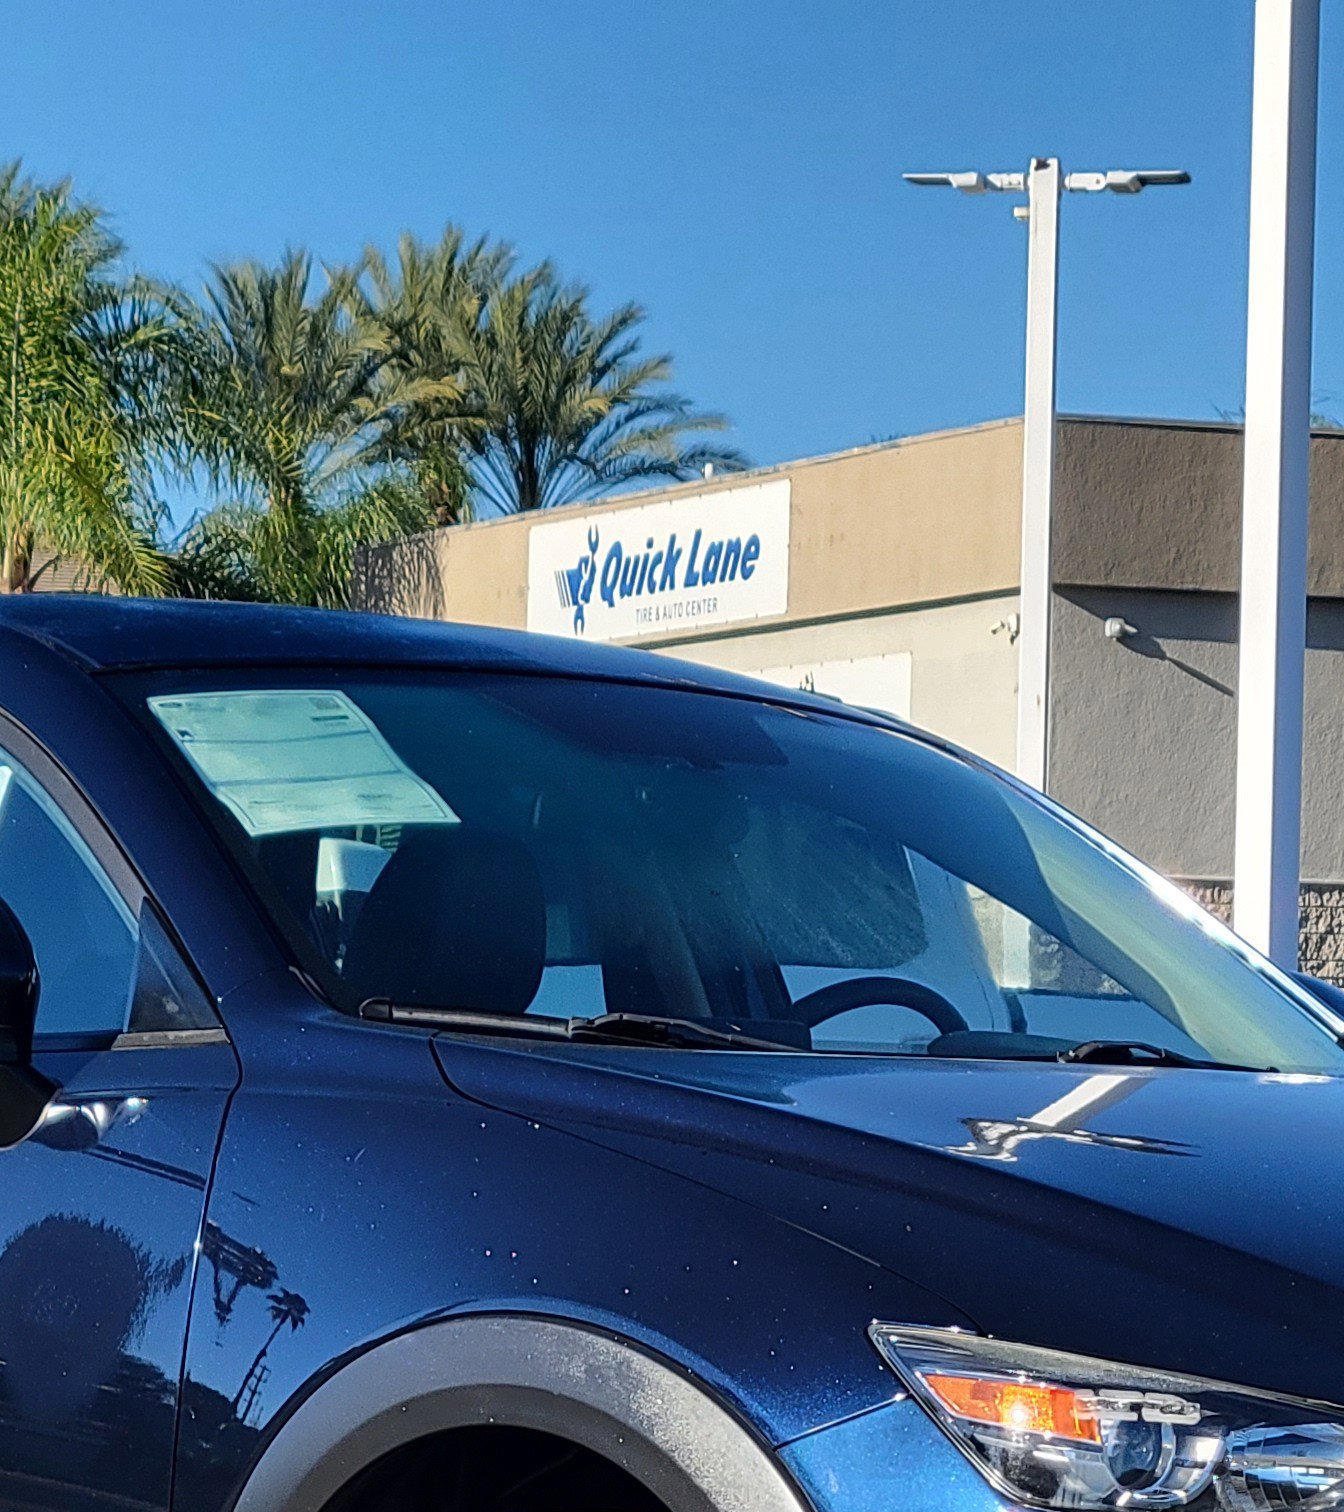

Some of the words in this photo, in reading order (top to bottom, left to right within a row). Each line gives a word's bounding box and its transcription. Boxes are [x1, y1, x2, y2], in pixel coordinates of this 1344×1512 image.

[600, 533, 682, 608] Quick
[683, 528, 760, 588] Lane
[635, 607, 653, 625] TIRE
[655, 606, 660, 621] &
[662, 603, 684, 621] AUTO
[686, 597, 718, 618] CENTER
